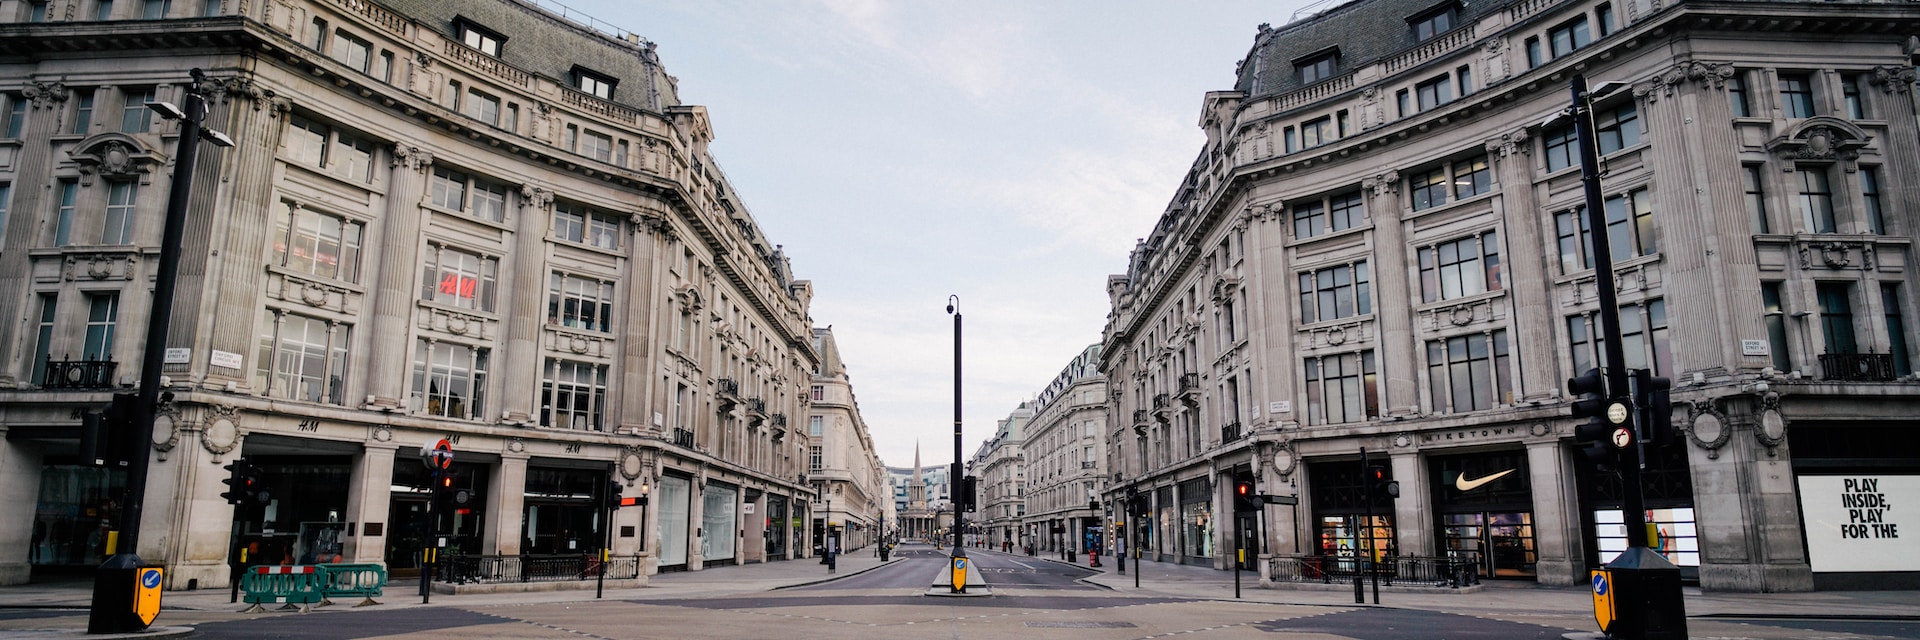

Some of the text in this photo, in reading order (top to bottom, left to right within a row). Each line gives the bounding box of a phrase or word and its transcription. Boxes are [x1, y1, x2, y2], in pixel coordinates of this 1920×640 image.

[1425, 427, 1515, 441] NIKETOWN
[1843, 478, 1878, 493] PLAY
[1841, 493, 1891, 511] INSIDE,
[1849, 508, 1883, 523] PLAY
[1841, 523, 1899, 539] FOR THE
